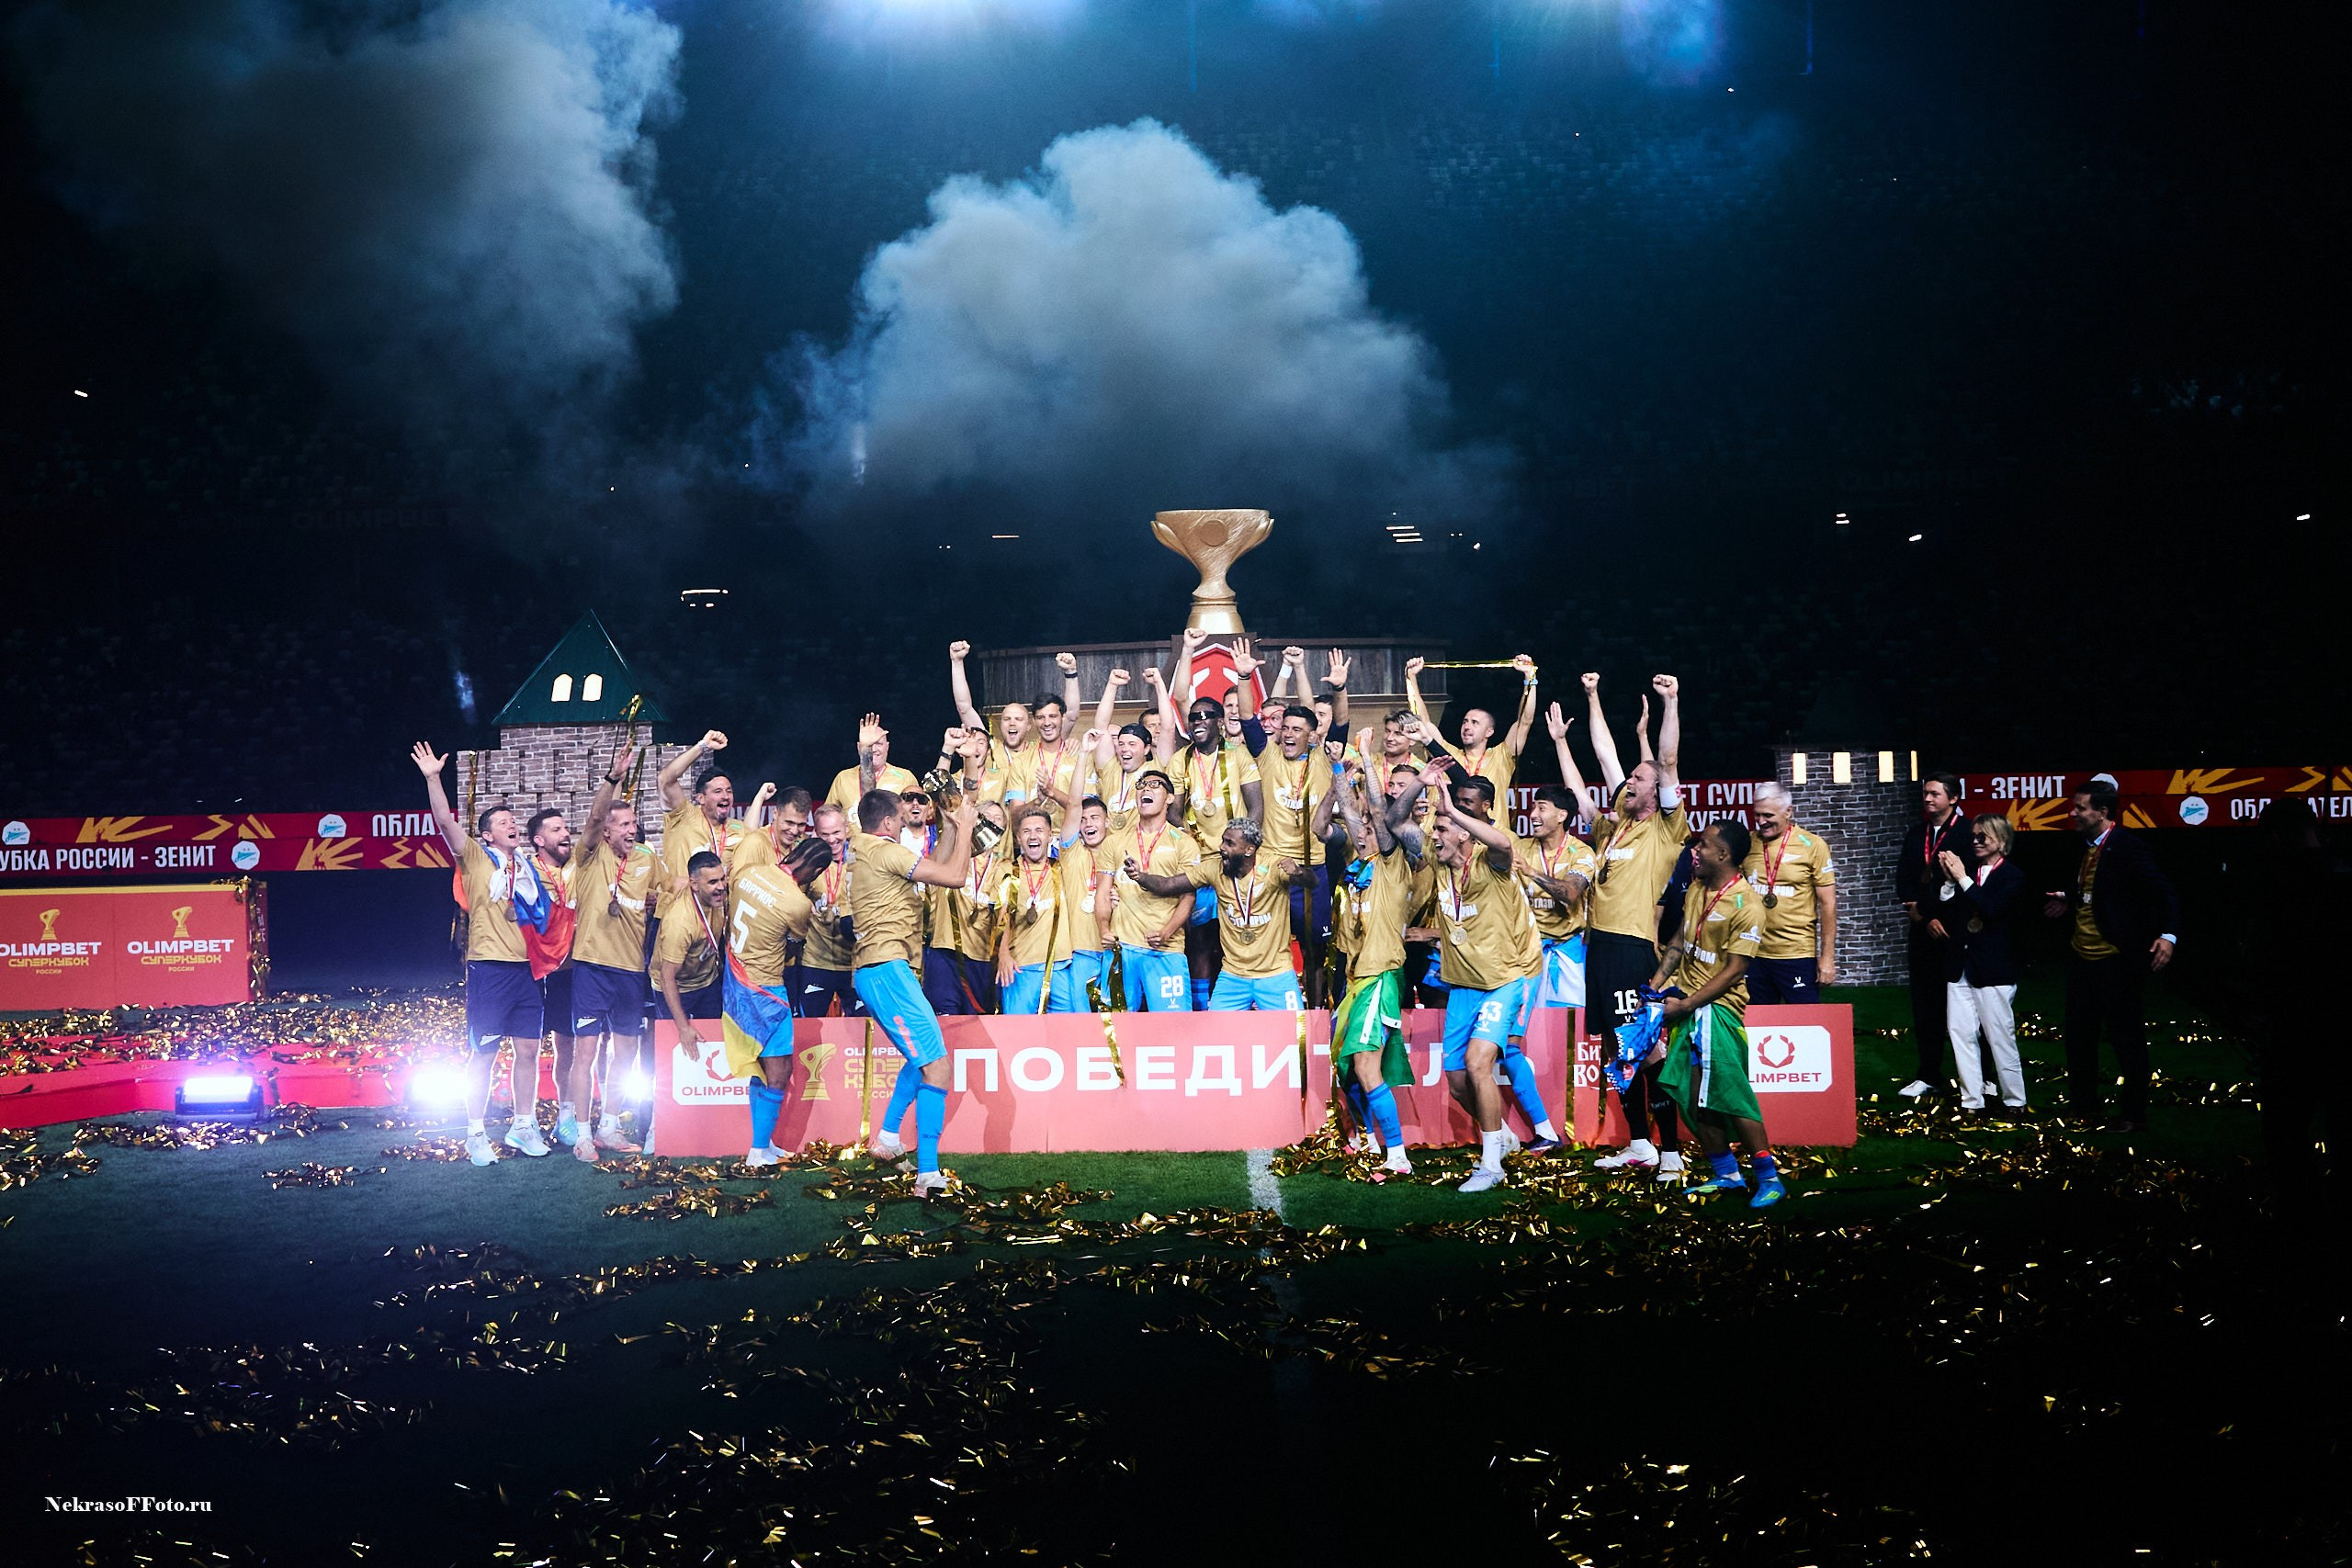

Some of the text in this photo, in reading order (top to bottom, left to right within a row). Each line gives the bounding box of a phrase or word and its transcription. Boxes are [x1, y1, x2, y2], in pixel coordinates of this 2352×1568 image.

[1991, 775, 2066, 799] ЗЕНИТ
[372, 813, 442, 837] ОБЛА
[56, 847, 134, 870] РОССИИ
[154, 845, 216, 868] ЗЕНИТ
[739, 877, 777, 908] БАРРИОС
[730, 898, 758, 954] 5
[0, 942, 102, 956] OLIMPBET
[127, 939, 234, 954] OLIMPBET
[8, 957, 89, 967] СУПЕРКУБОК
[141, 954, 221, 964] СУПЕРКУБОК
[1160, 976, 1183, 998] 28
[1284, 990, 1298, 1010] 8
[1614, 989, 1638, 1014] 16
[1577, 1042, 1601, 1066] Би
